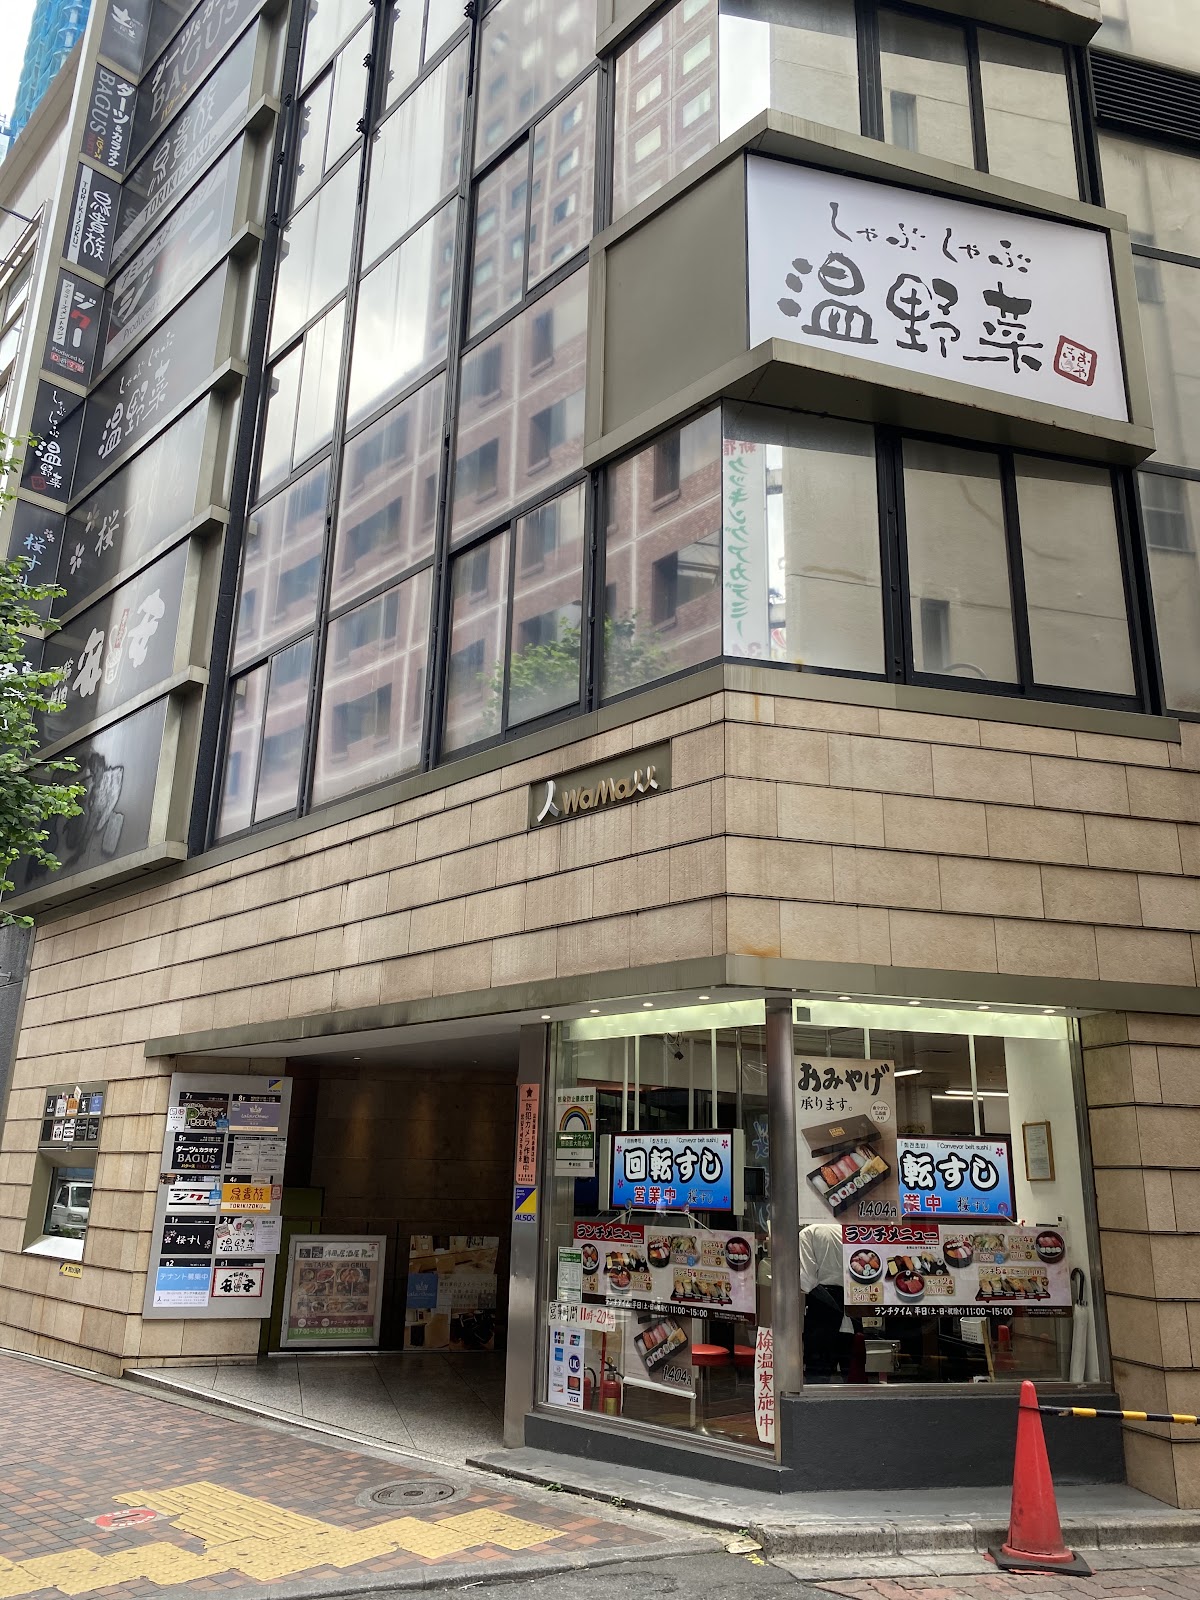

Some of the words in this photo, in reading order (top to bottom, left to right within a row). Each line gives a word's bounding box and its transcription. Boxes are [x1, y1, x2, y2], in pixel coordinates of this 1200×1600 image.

[90, 69, 115, 136] BAGUS
[829, 202, 1031, 273] しゃぶしゃぶ
[777, 251, 1043, 373] 温野菜
[98, 358, 171, 459] 温野菜
[35, 441, 63, 488] 温野菜
[798, 1062, 890, 1096] おみやげ
[177, 1154, 217, 1163] BAGUS
[623, 1146, 723, 1184] 回転すし
[900, 1150, 1000, 1192] 転すし
[634, 1186, 676, 1205] 営業中
[514, 1214, 537, 1222] ALSOK
[577, 1223, 642, 1240] ランチメニュー
[845, 1226, 938, 1242] ランチメニュー
[176, 1235, 200, 1245] 桜すし
[569, 1358, 580, 1370] UC
[568, 1395, 579, 1403] VISA
[757, 1330, 774, 1437] 検温実施中
